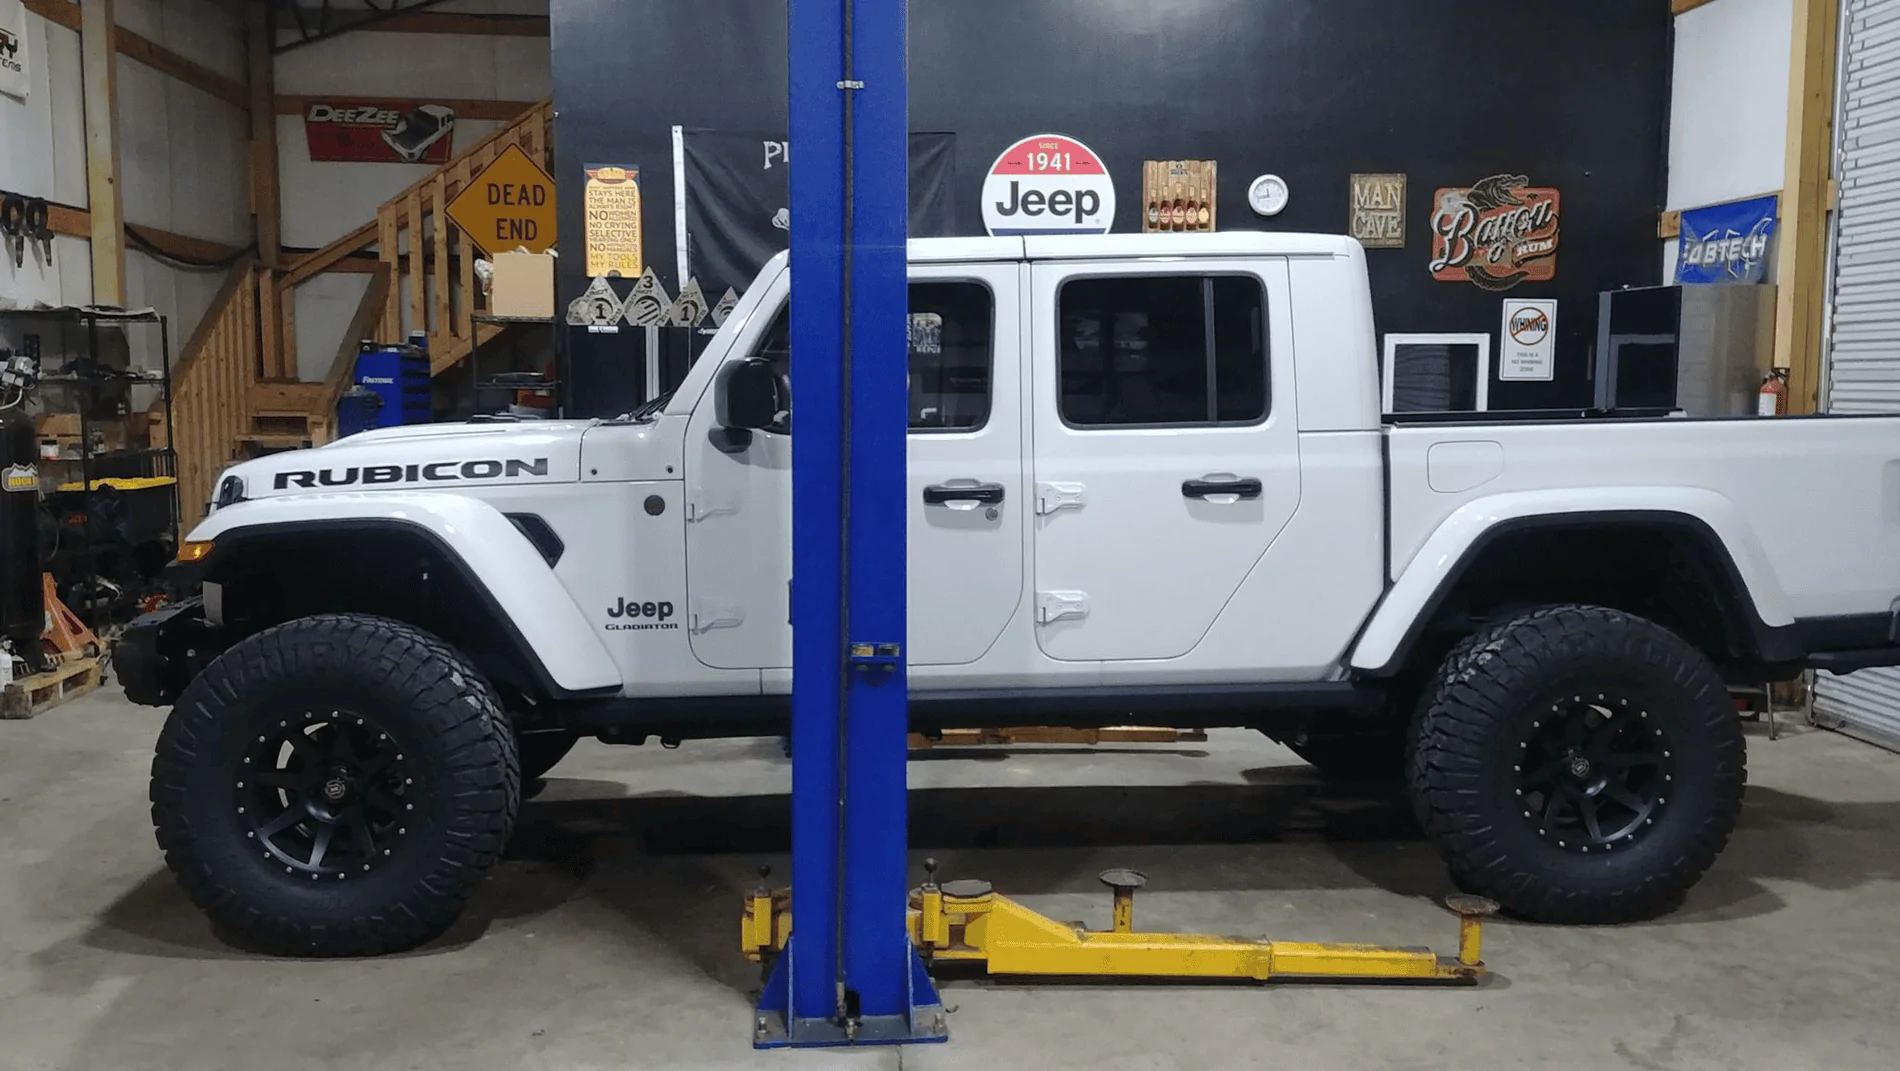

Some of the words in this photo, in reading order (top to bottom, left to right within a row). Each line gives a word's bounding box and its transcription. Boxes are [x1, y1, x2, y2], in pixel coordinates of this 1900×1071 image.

[1026, 152, 1071, 171] 1941
[487, 183, 546, 207] DEAD
[588, 189, 613, 197] STAYS
[615, 190, 636, 198] HERE
[1354, 182, 1403, 212] MAN
[588, 197, 604, 205] THE
[628, 198, 636, 206] IS
[995, 181, 1100, 224] Jeep
[588, 210, 609, 221] NO
[496, 218, 538, 241] END
[589, 221, 603, 229] NO
[604, 221, 637, 229] CRYING
[1353, 211, 1401, 238] CAVE
[589, 230, 637, 238] SELECTIVE
[589, 243, 606, 252] NO
[1516, 239, 1553, 257] RUM
[608, 253, 638, 261] TOOLS
[608, 261, 639, 269] RULES
[643, 275, 654, 289] 3
[595, 304, 607, 320] 1
[681, 305, 690, 321] 1
[1511, 317, 1547, 332] WHINING
[273, 457, 548, 490] RUBICON
[607, 597, 673, 621] Jeep
[605, 623, 678, 631] GLADIATOR
